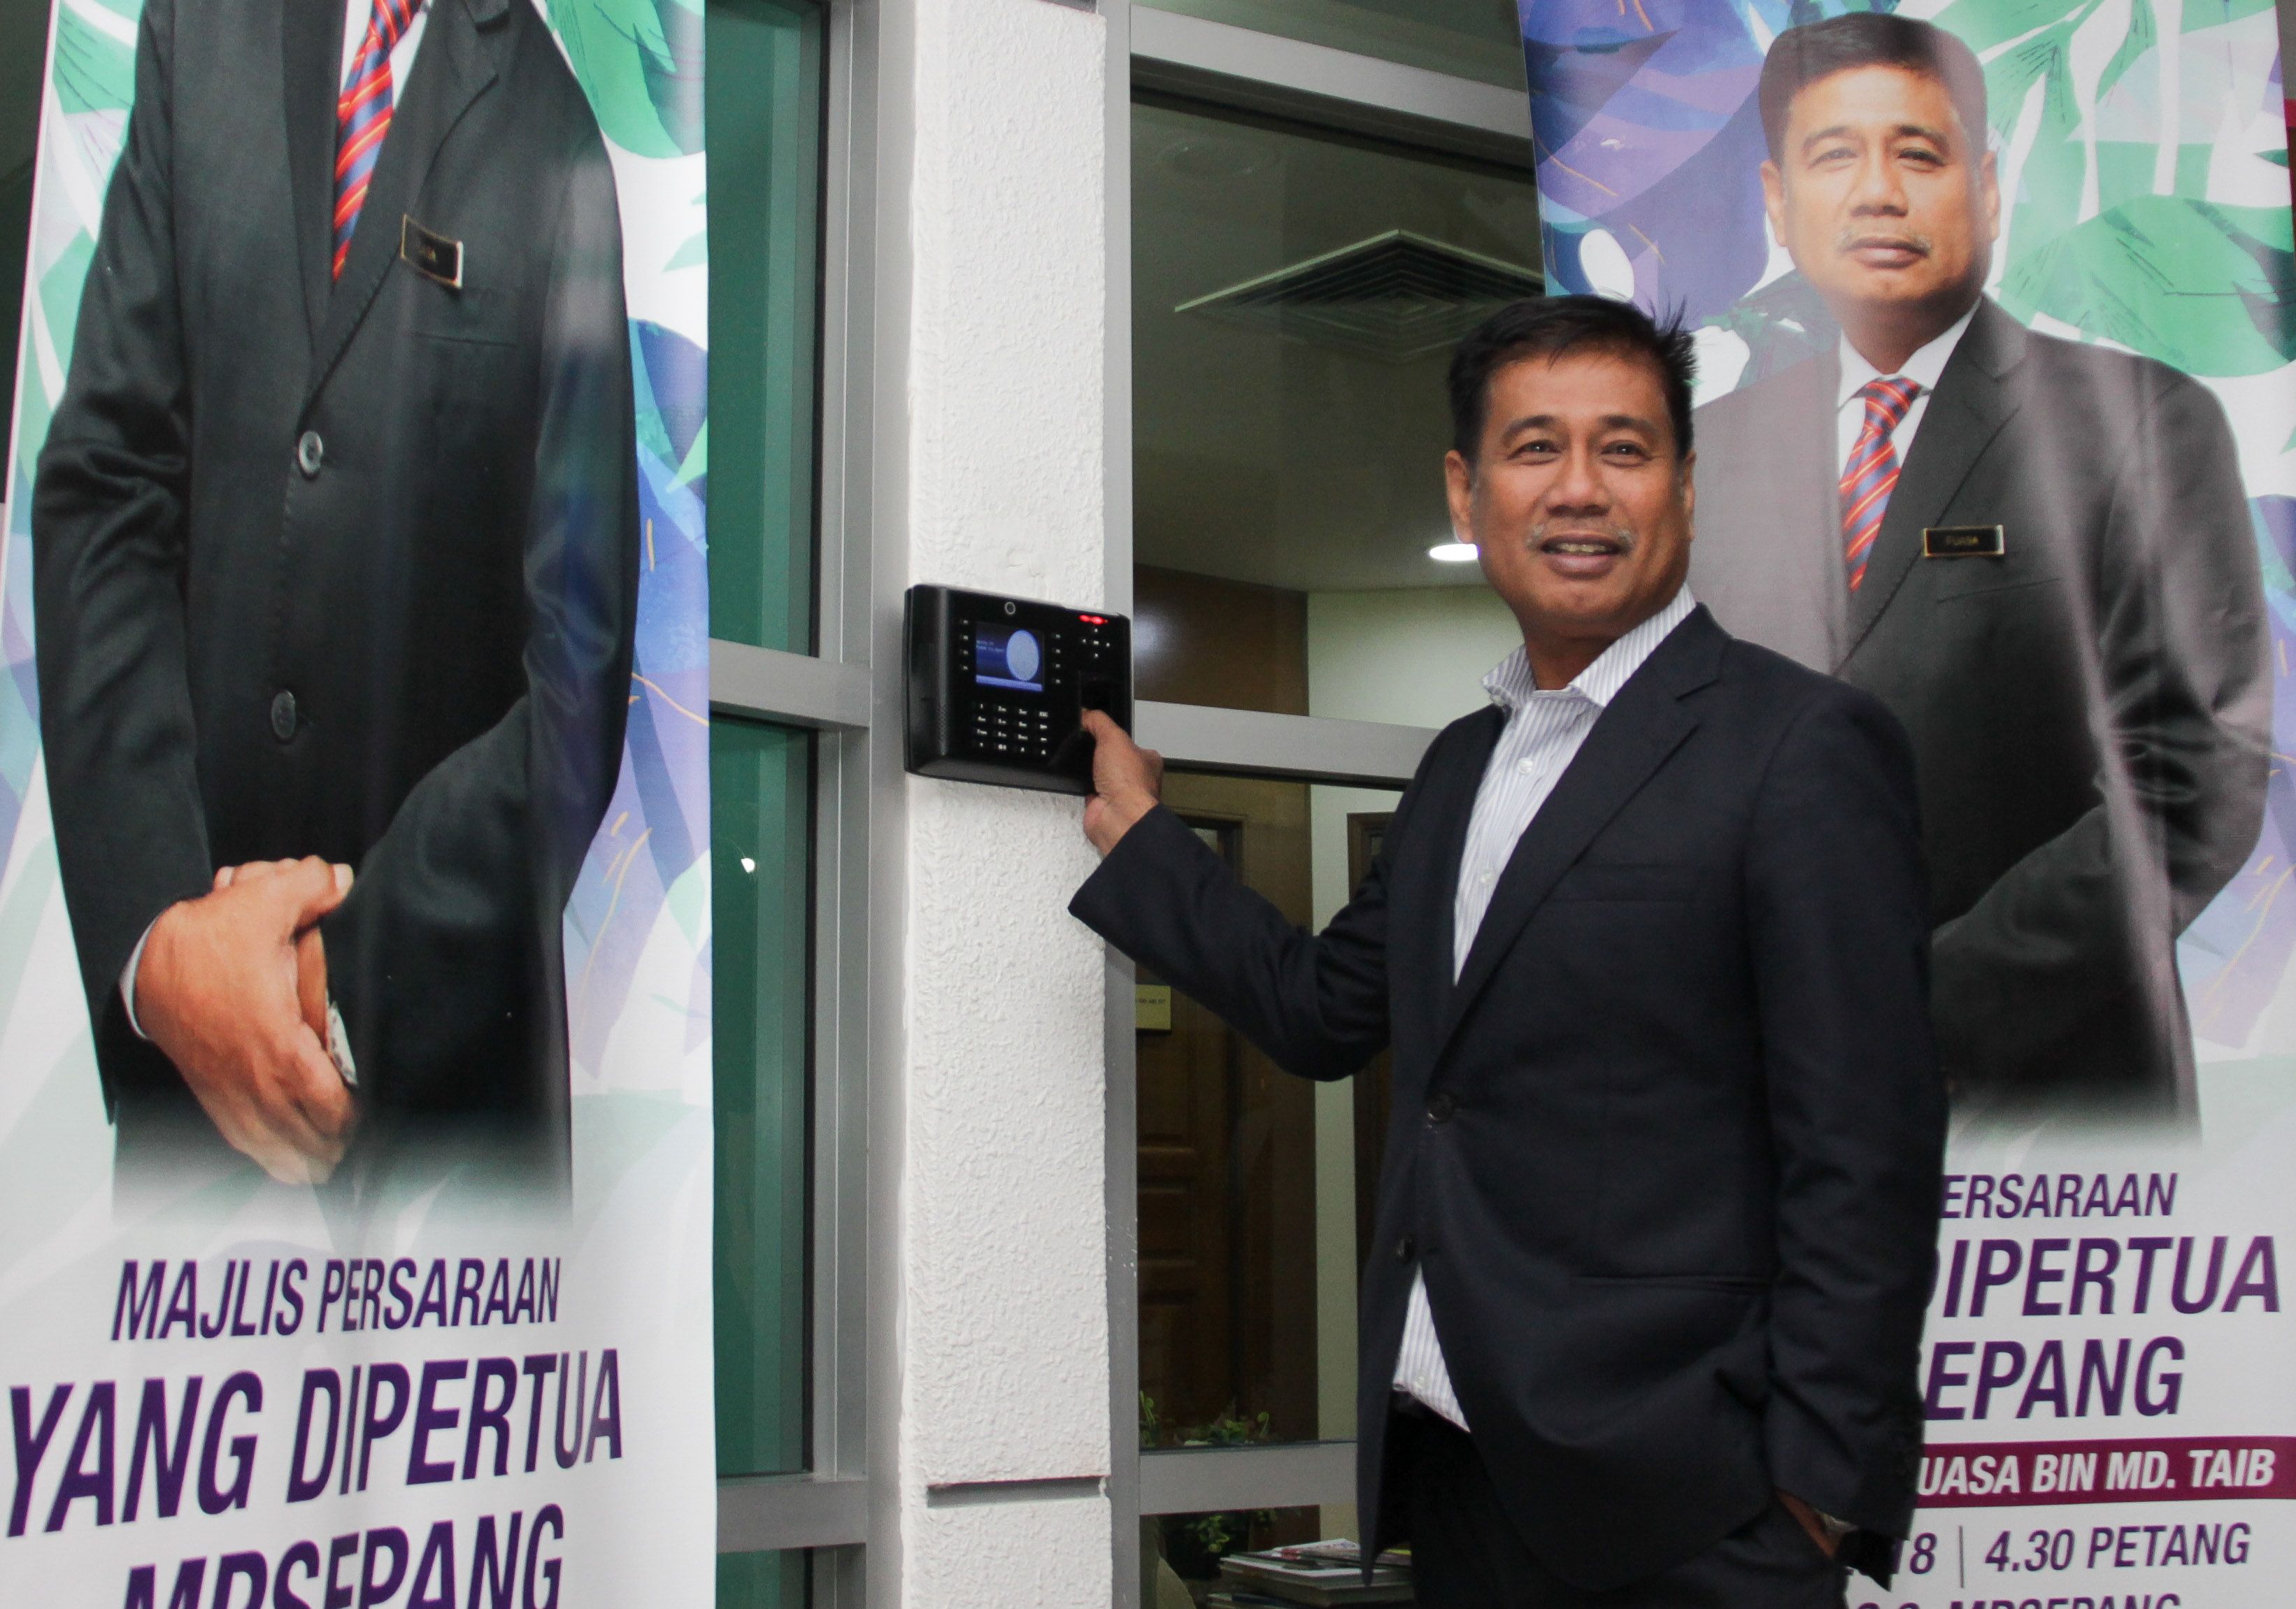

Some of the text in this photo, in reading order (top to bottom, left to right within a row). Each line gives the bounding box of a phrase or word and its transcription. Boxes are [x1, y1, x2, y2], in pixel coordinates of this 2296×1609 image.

[111, 1257, 560, 1341] MAJLIS PERSARAAN
[1925, 1236, 2281, 1319] IPERTUA
[7, 1348, 622, 1538] YANG DIPERTUA
[2032, 1454, 2097, 1492] BIN
[2106, 1451, 2175, 1489] MD.
[2190, 1449, 2276, 1487] TAIB
[1984, 1529, 2075, 1572] 4.30
[2087, 1522, 2251, 1568] PETANG
